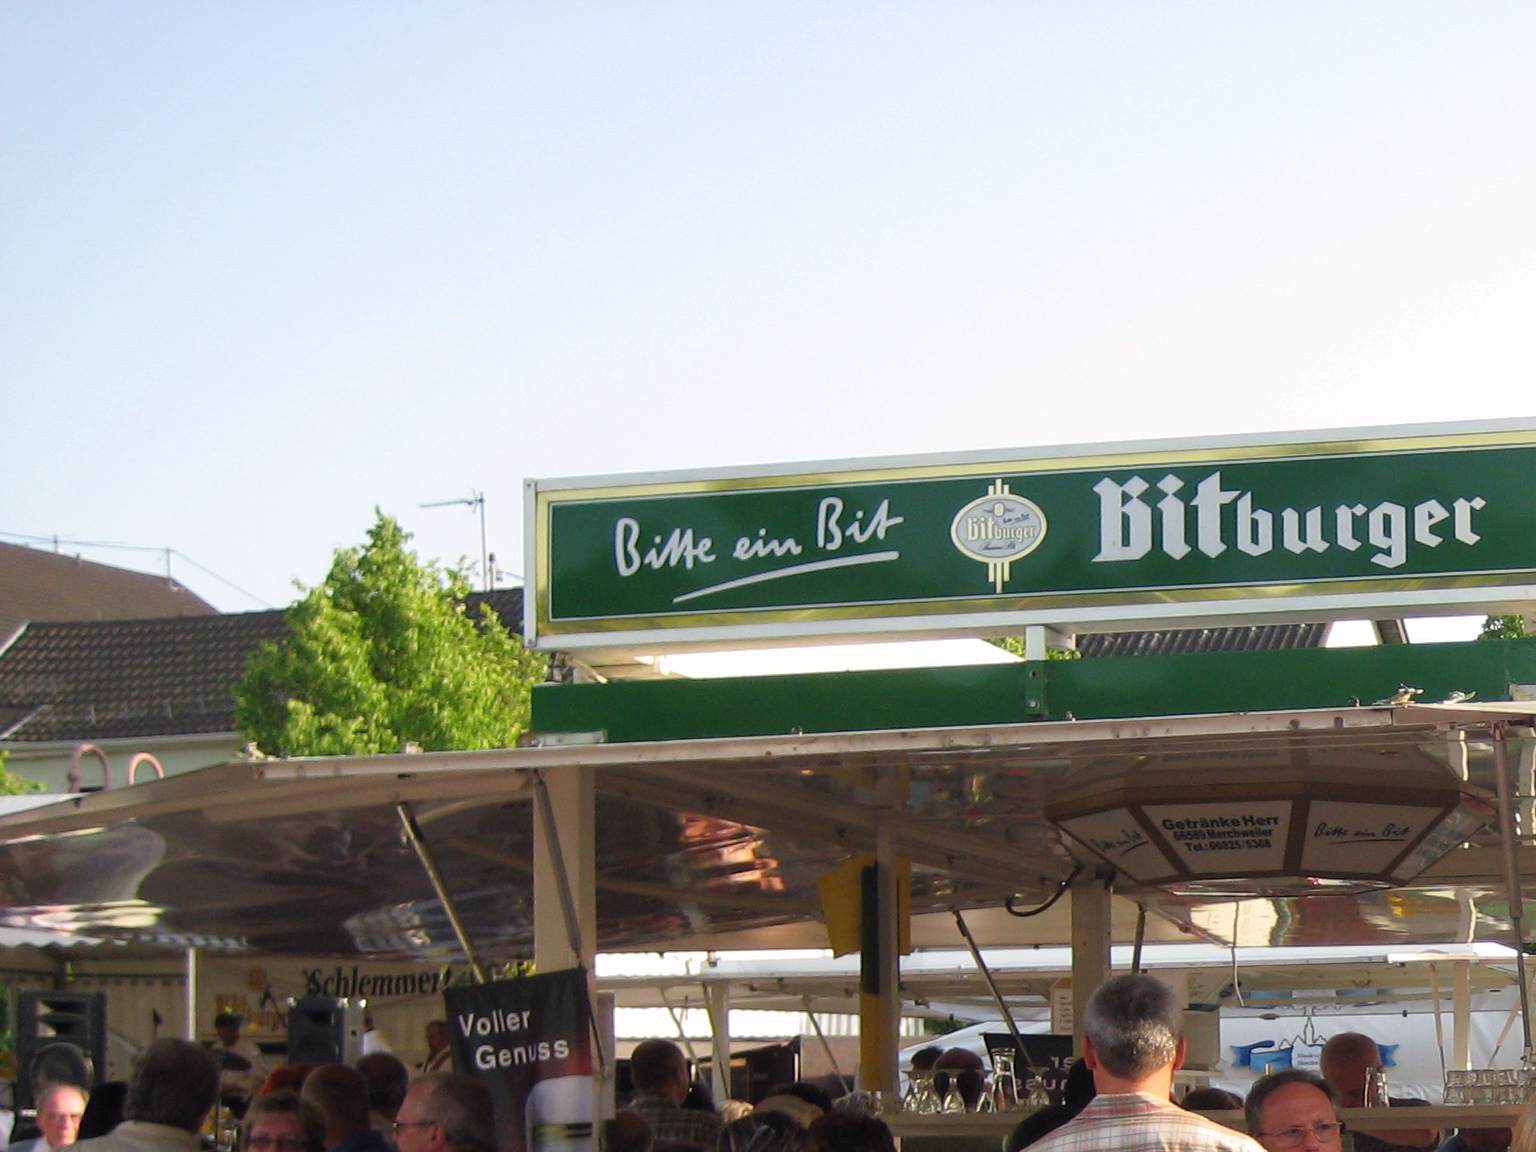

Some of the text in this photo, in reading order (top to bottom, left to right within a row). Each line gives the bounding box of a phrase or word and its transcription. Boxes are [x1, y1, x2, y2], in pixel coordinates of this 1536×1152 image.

[1092, 470, 1487, 569] Bitburger
[615, 497, 903, 577] Bitte ein Bit
[1162, 815, 1279, 830] Getränke Herr
[303, 966, 451, 996] Schlemmer
[459, 1008, 531, 1037] Voller
[476, 1039, 570, 1070] Genuss
